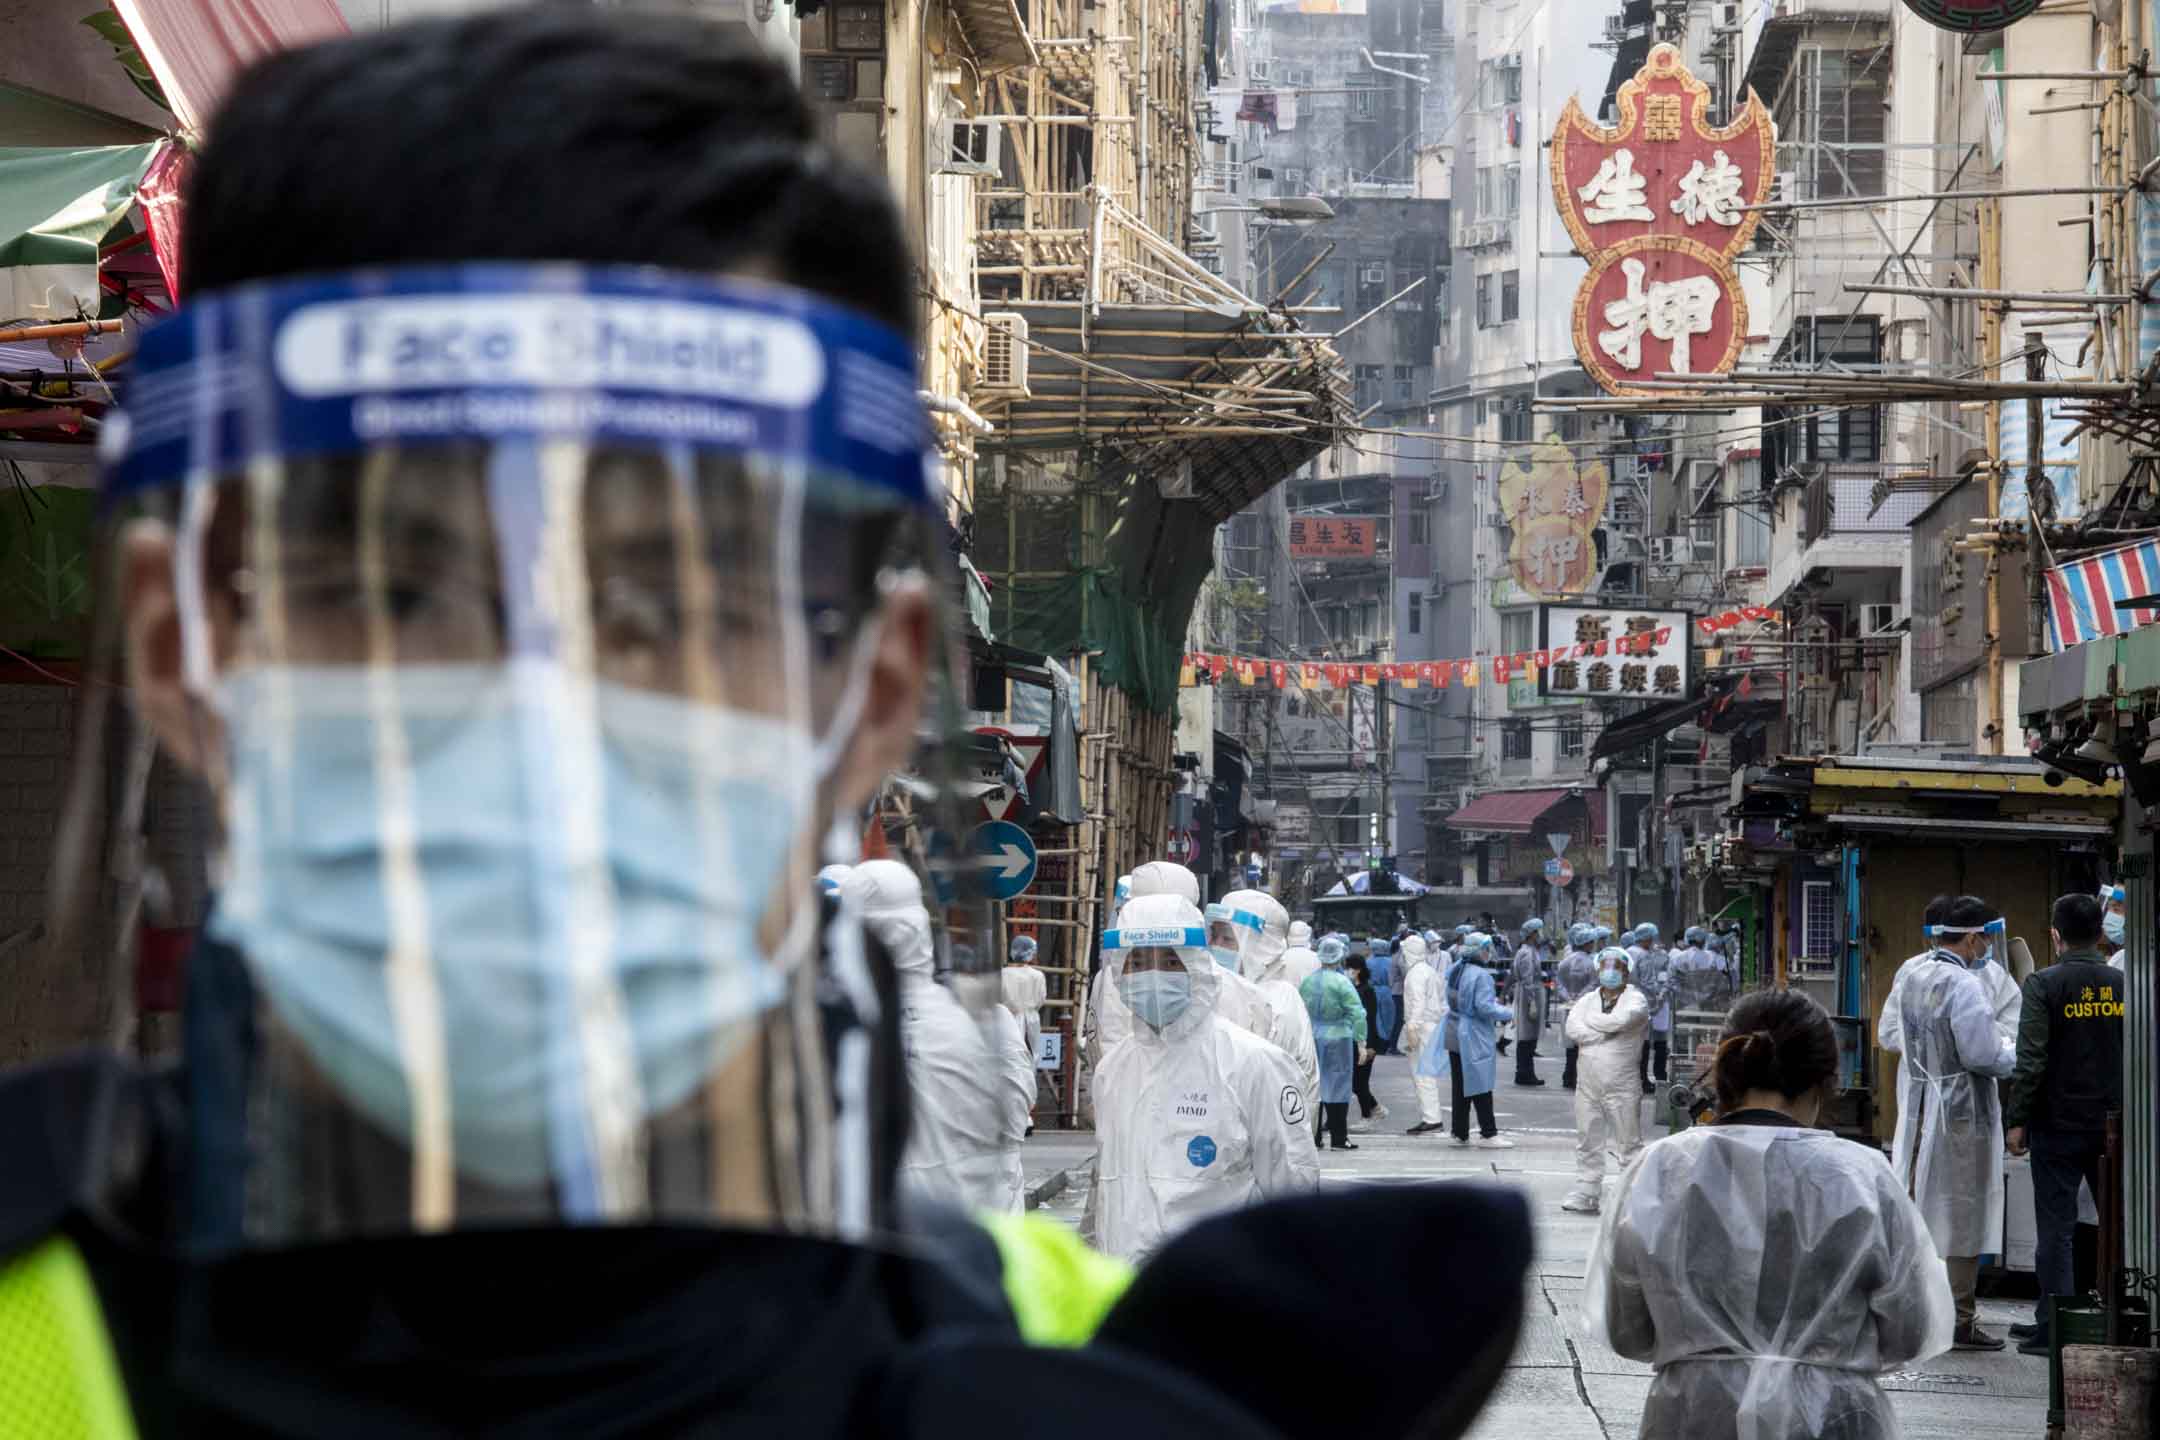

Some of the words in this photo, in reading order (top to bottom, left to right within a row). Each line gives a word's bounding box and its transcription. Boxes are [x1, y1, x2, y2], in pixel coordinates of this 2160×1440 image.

[1598, 257, 1720, 374] 押
[342, 308, 512, 370] Face
[542, 310, 766, 380] Shield
[1124, 931, 1144, 940] Face
[1148, 929, 1179, 940] Shield
[2082, 986, 2113, 1001] 海關
[1046, 1039, 1053, 1056] B
[1176, 1106, 1207, 1116] IMMD
